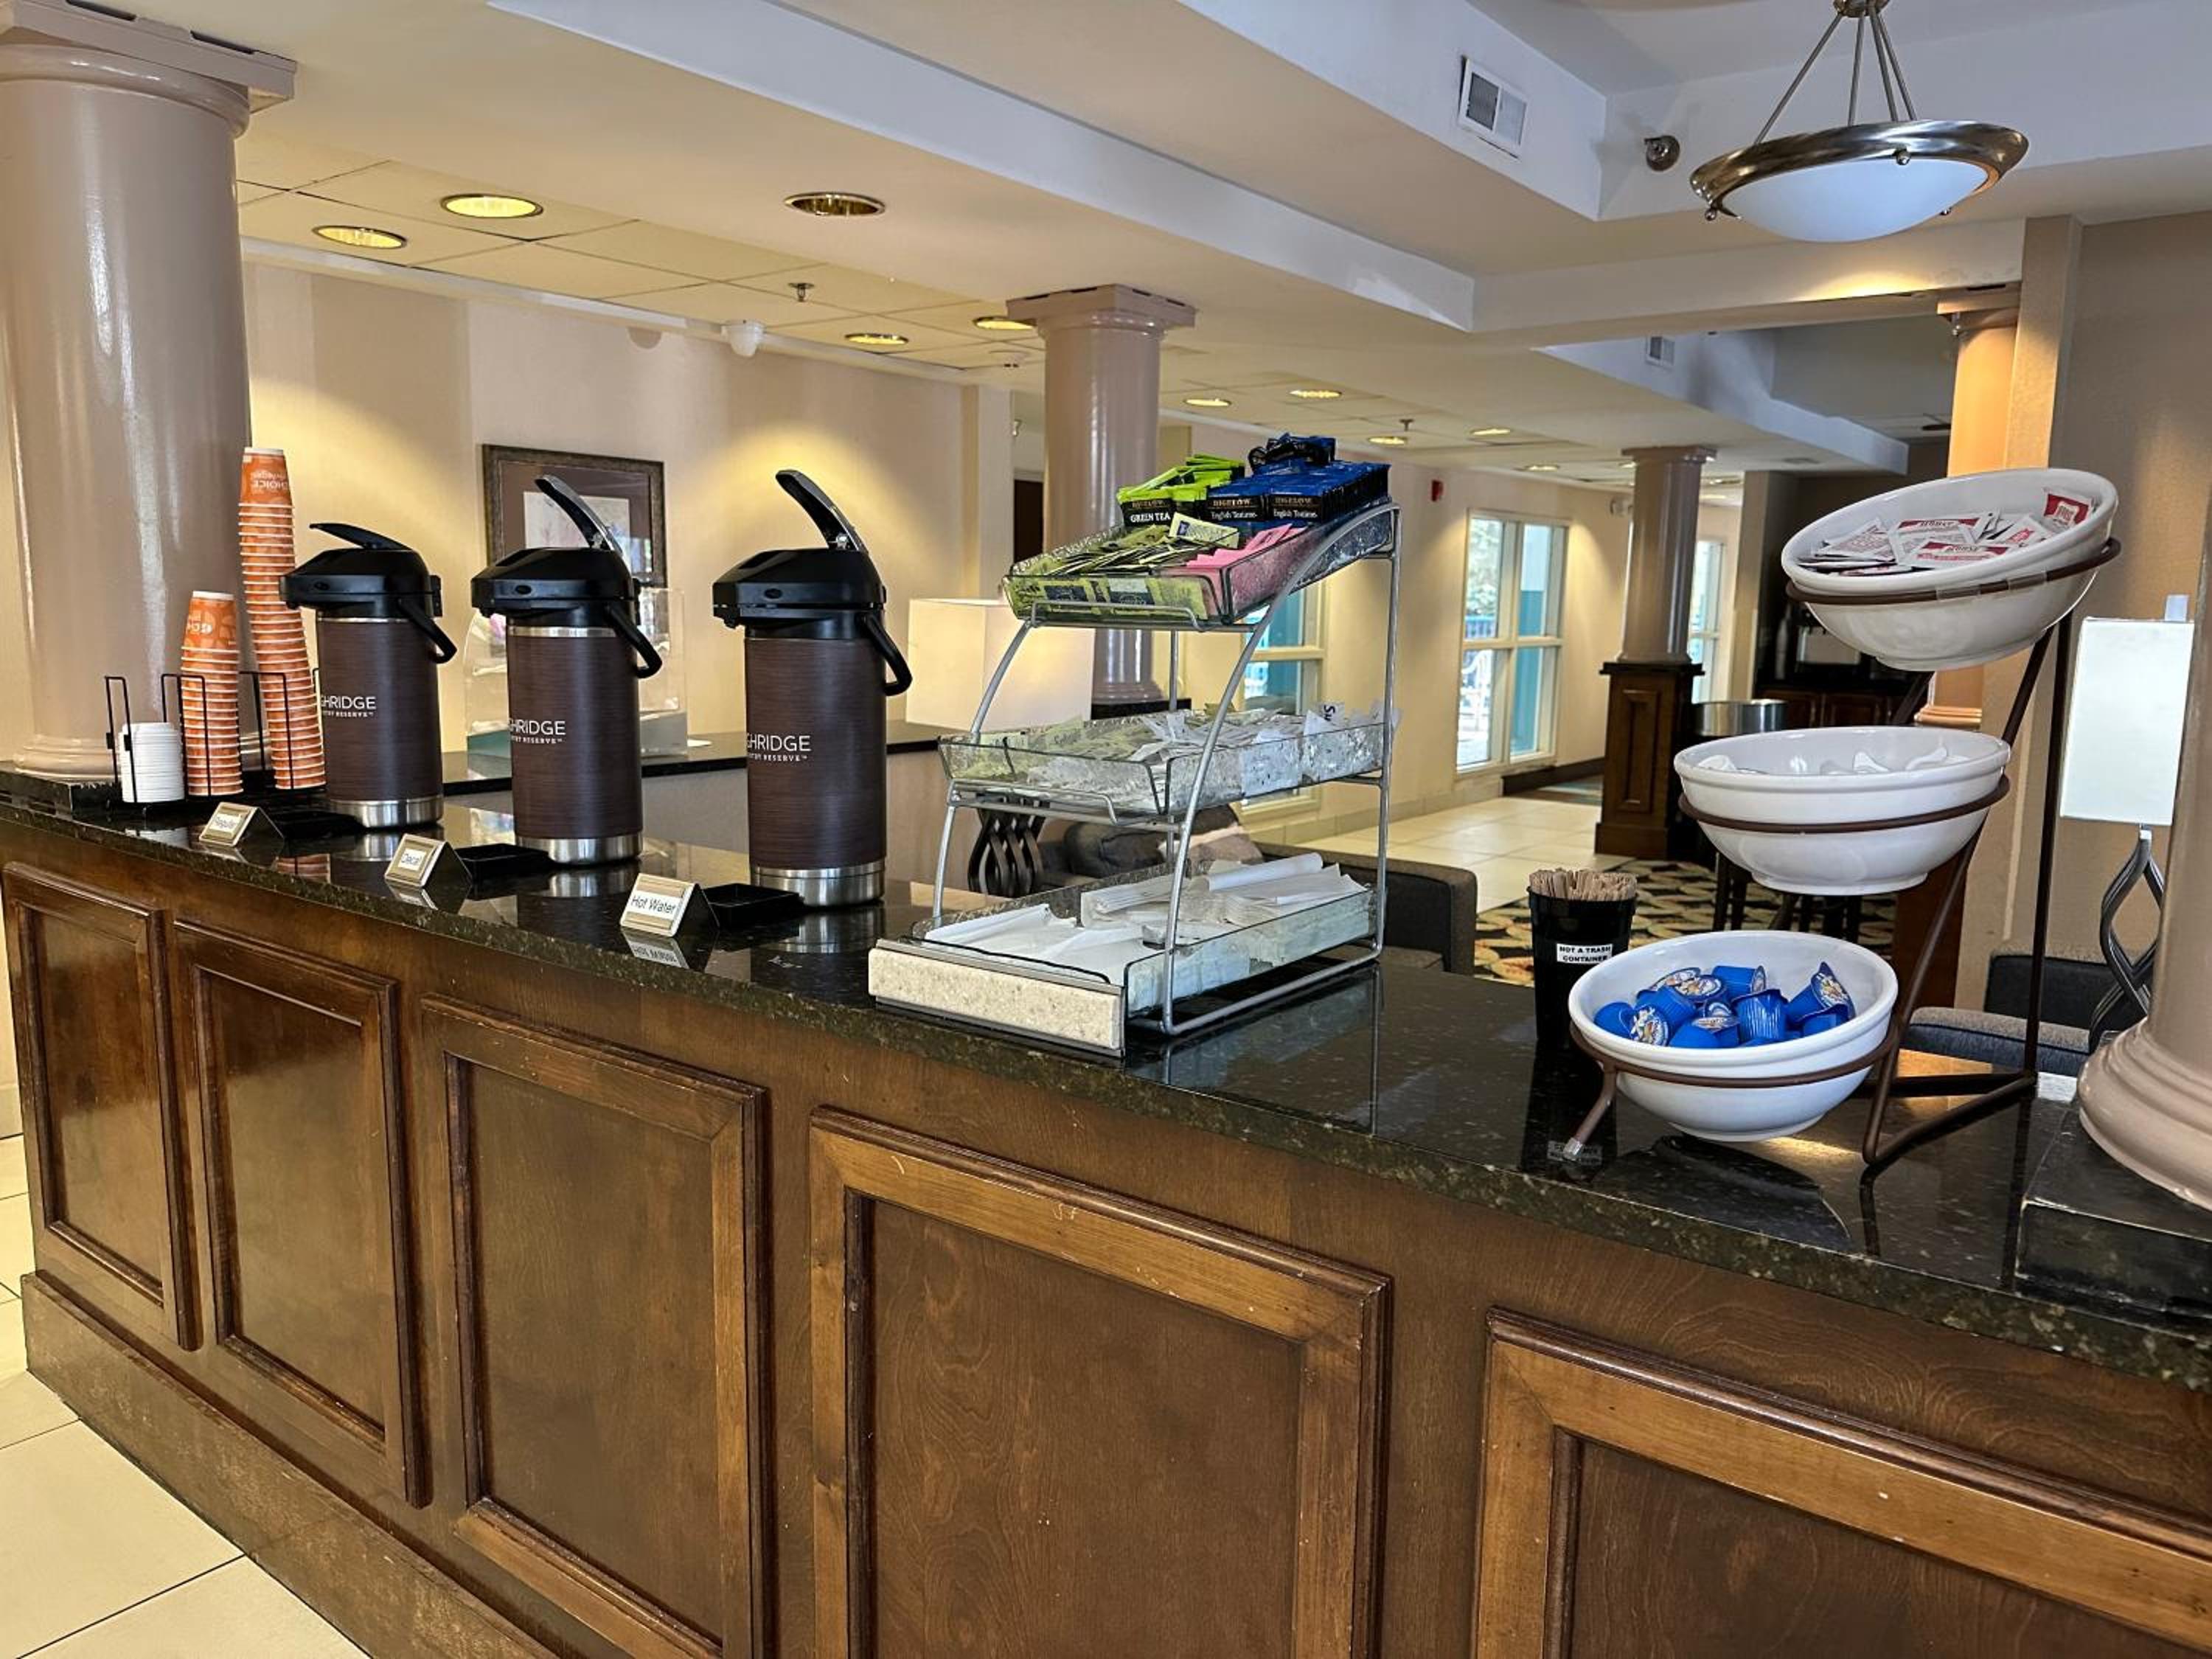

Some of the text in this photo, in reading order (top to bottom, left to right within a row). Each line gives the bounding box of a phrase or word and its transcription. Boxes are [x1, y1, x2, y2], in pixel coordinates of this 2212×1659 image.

[1130, 512, 1171, 523] GREEN TEA
[631, 895, 676, 914] Hot Water
